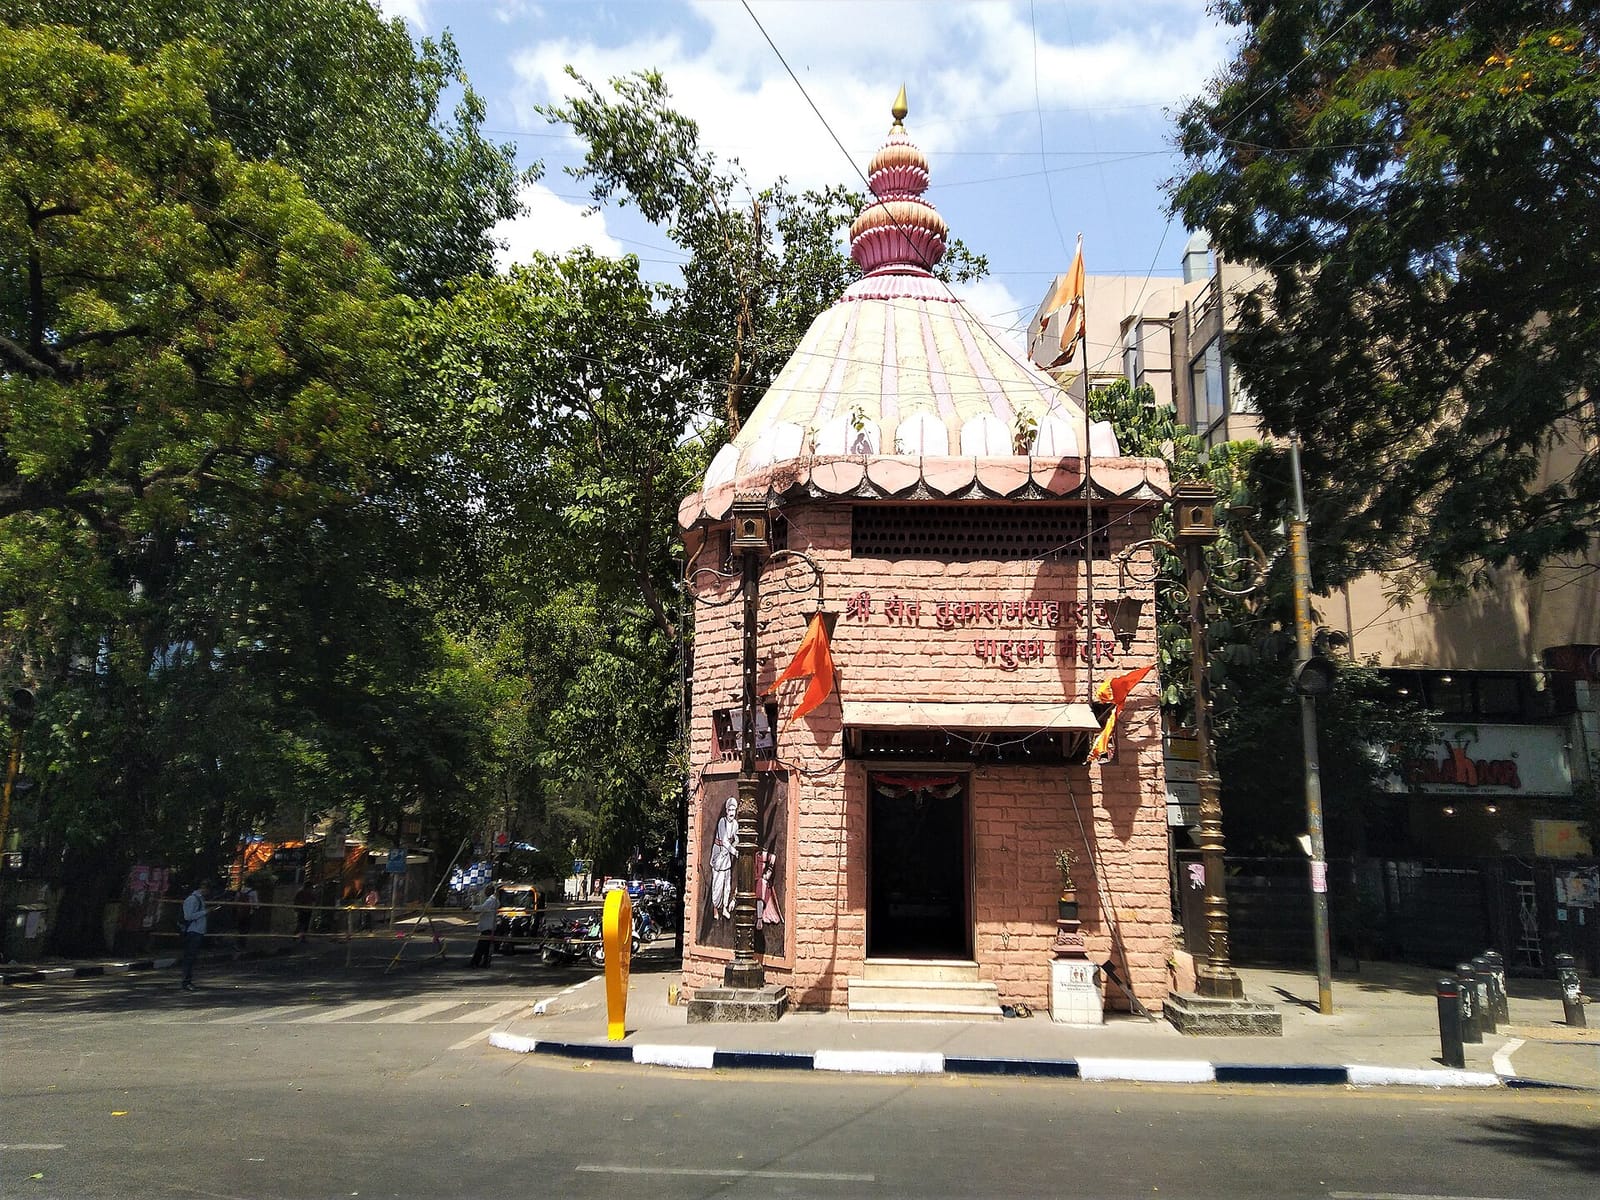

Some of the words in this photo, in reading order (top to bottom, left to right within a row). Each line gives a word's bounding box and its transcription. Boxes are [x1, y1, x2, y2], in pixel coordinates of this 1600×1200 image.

[846, 590, 871, 619] श्री
[883, 595, 921, 621] संत
[974, 639, 1045, 670] पादुका
